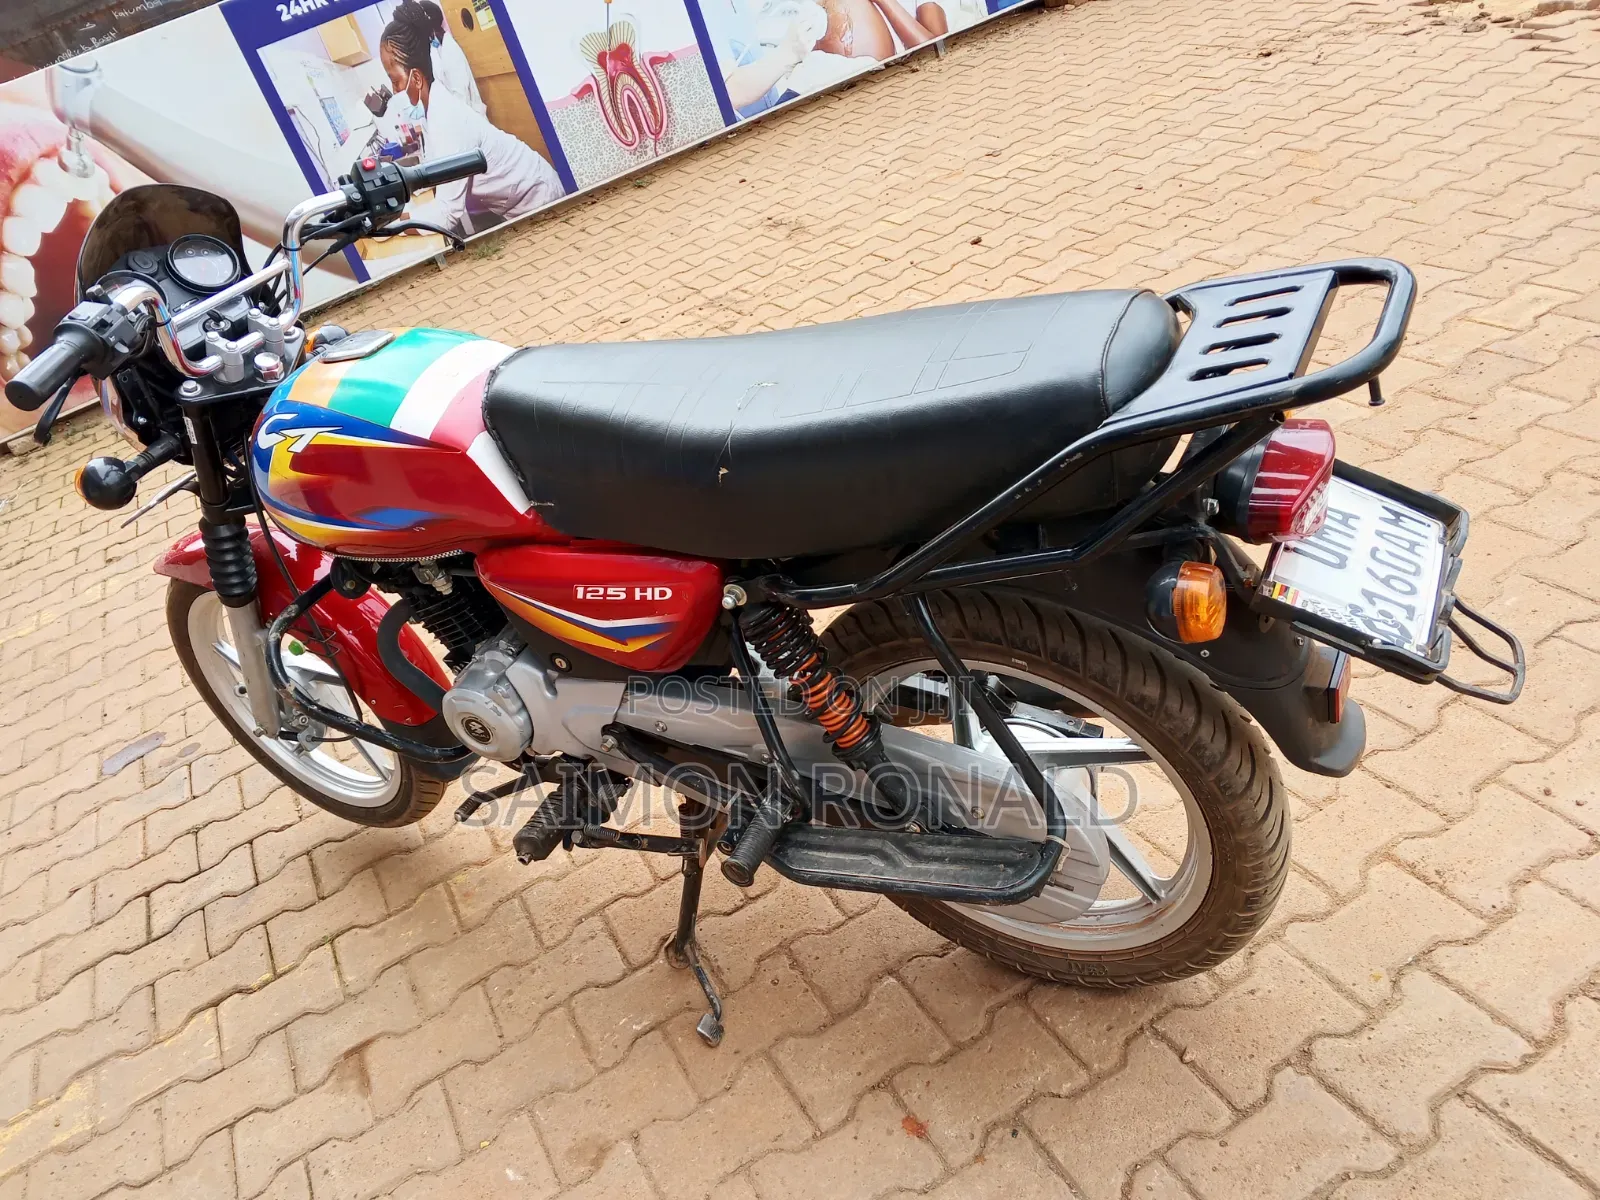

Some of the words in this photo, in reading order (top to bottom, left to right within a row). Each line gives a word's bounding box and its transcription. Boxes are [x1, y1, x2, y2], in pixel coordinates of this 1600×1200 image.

[576, 586, 627, 600] 125
[634, 587, 673, 601] HD
[1360, 505, 1431, 621] 160AM
